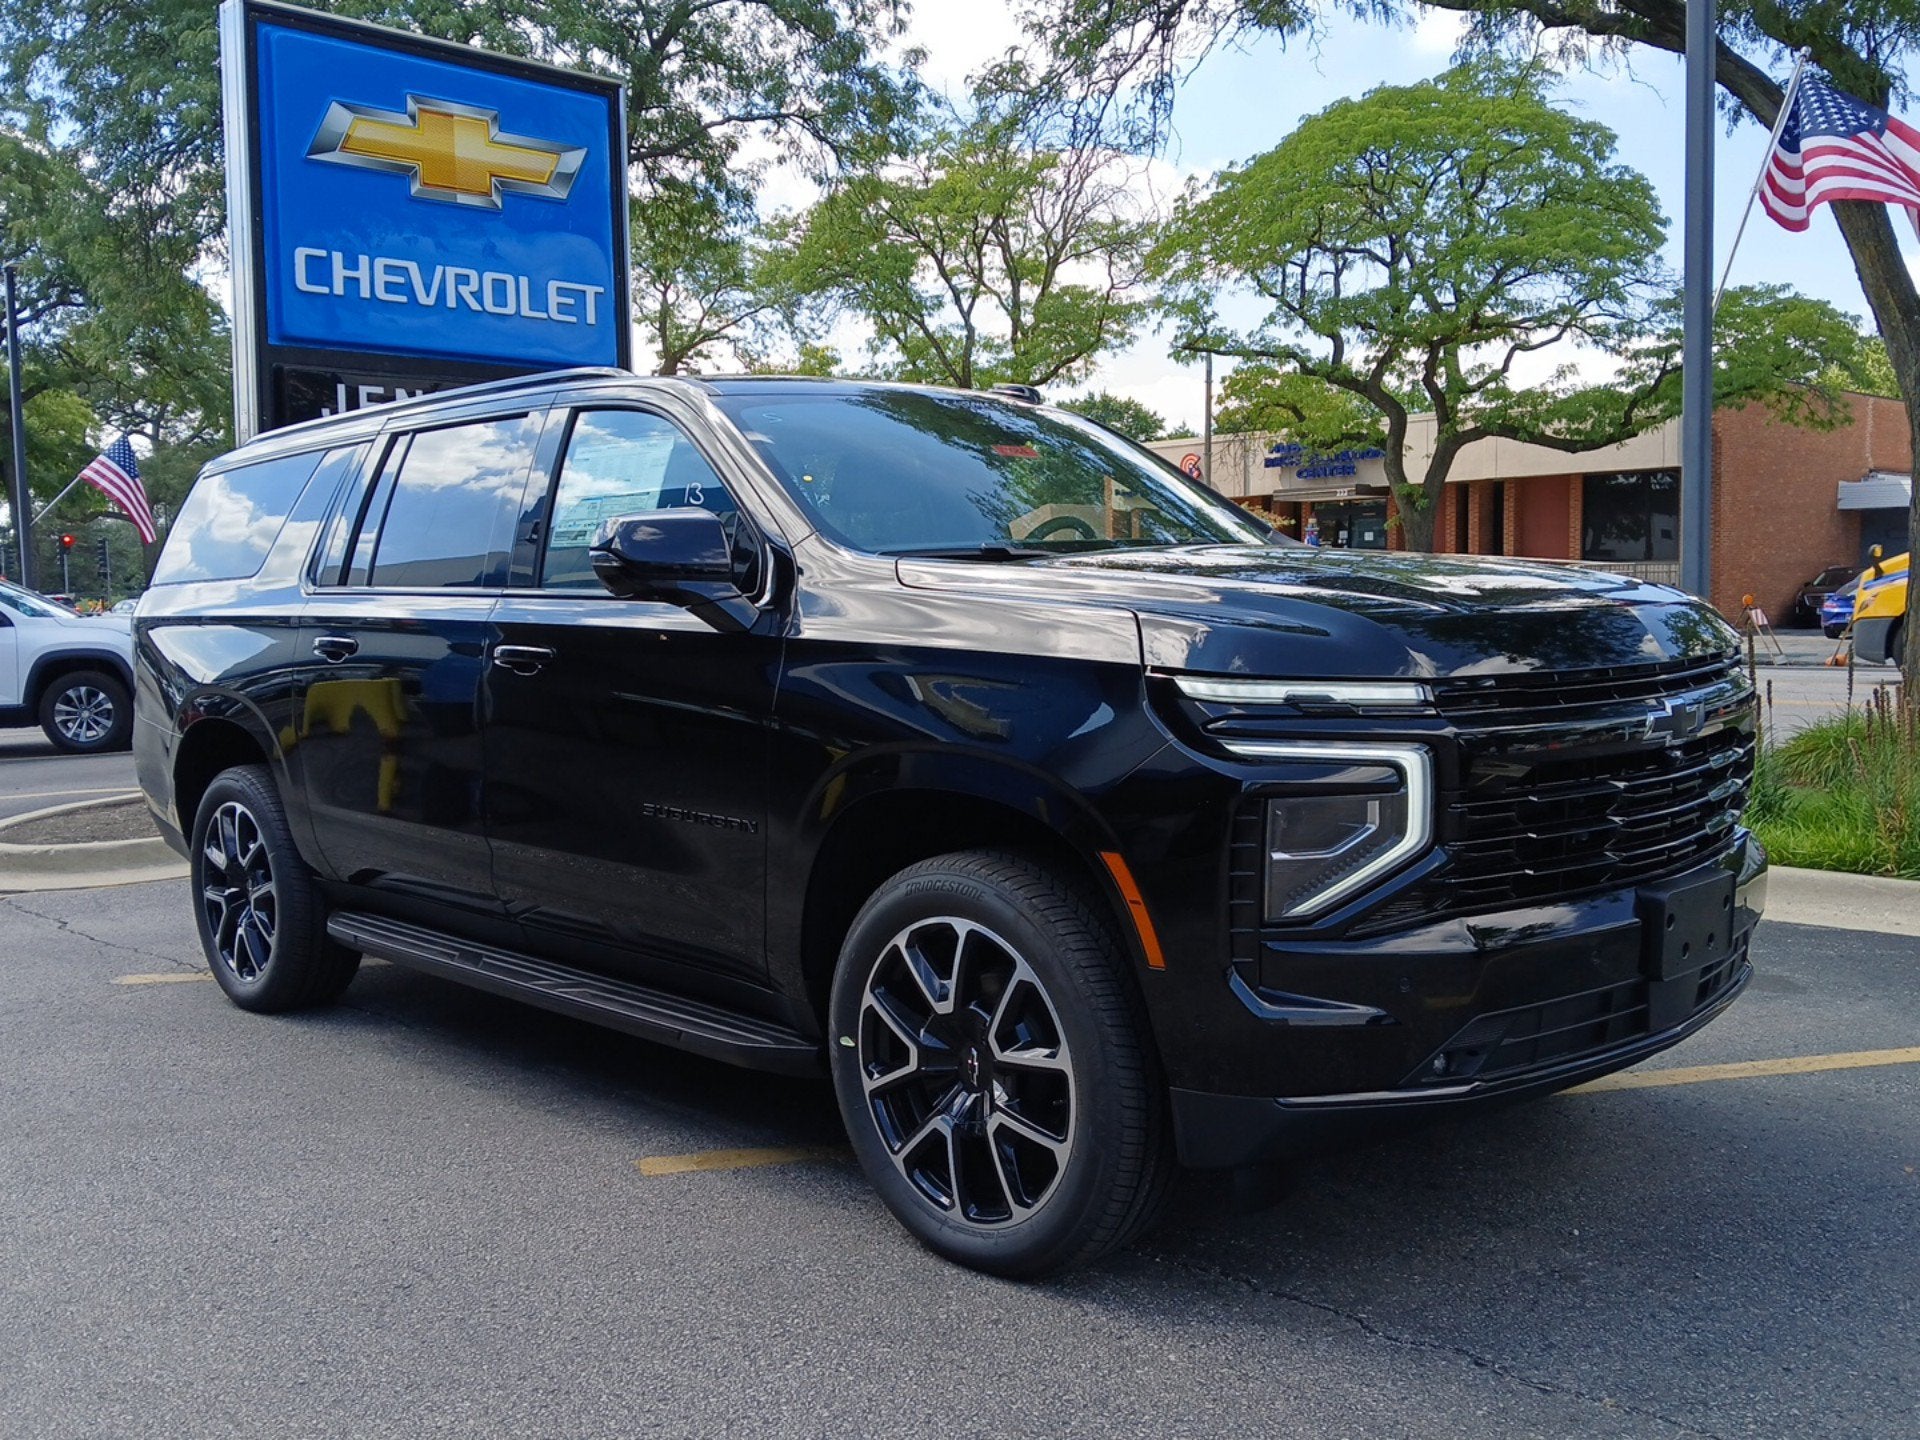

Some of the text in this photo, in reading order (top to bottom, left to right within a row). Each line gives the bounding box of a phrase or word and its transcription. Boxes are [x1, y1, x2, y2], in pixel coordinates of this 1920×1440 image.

[294, 246, 604, 324] CHEVROLET
[684, 482, 705, 505] 13
[904, 879, 987, 901] BRIDGESTONE
